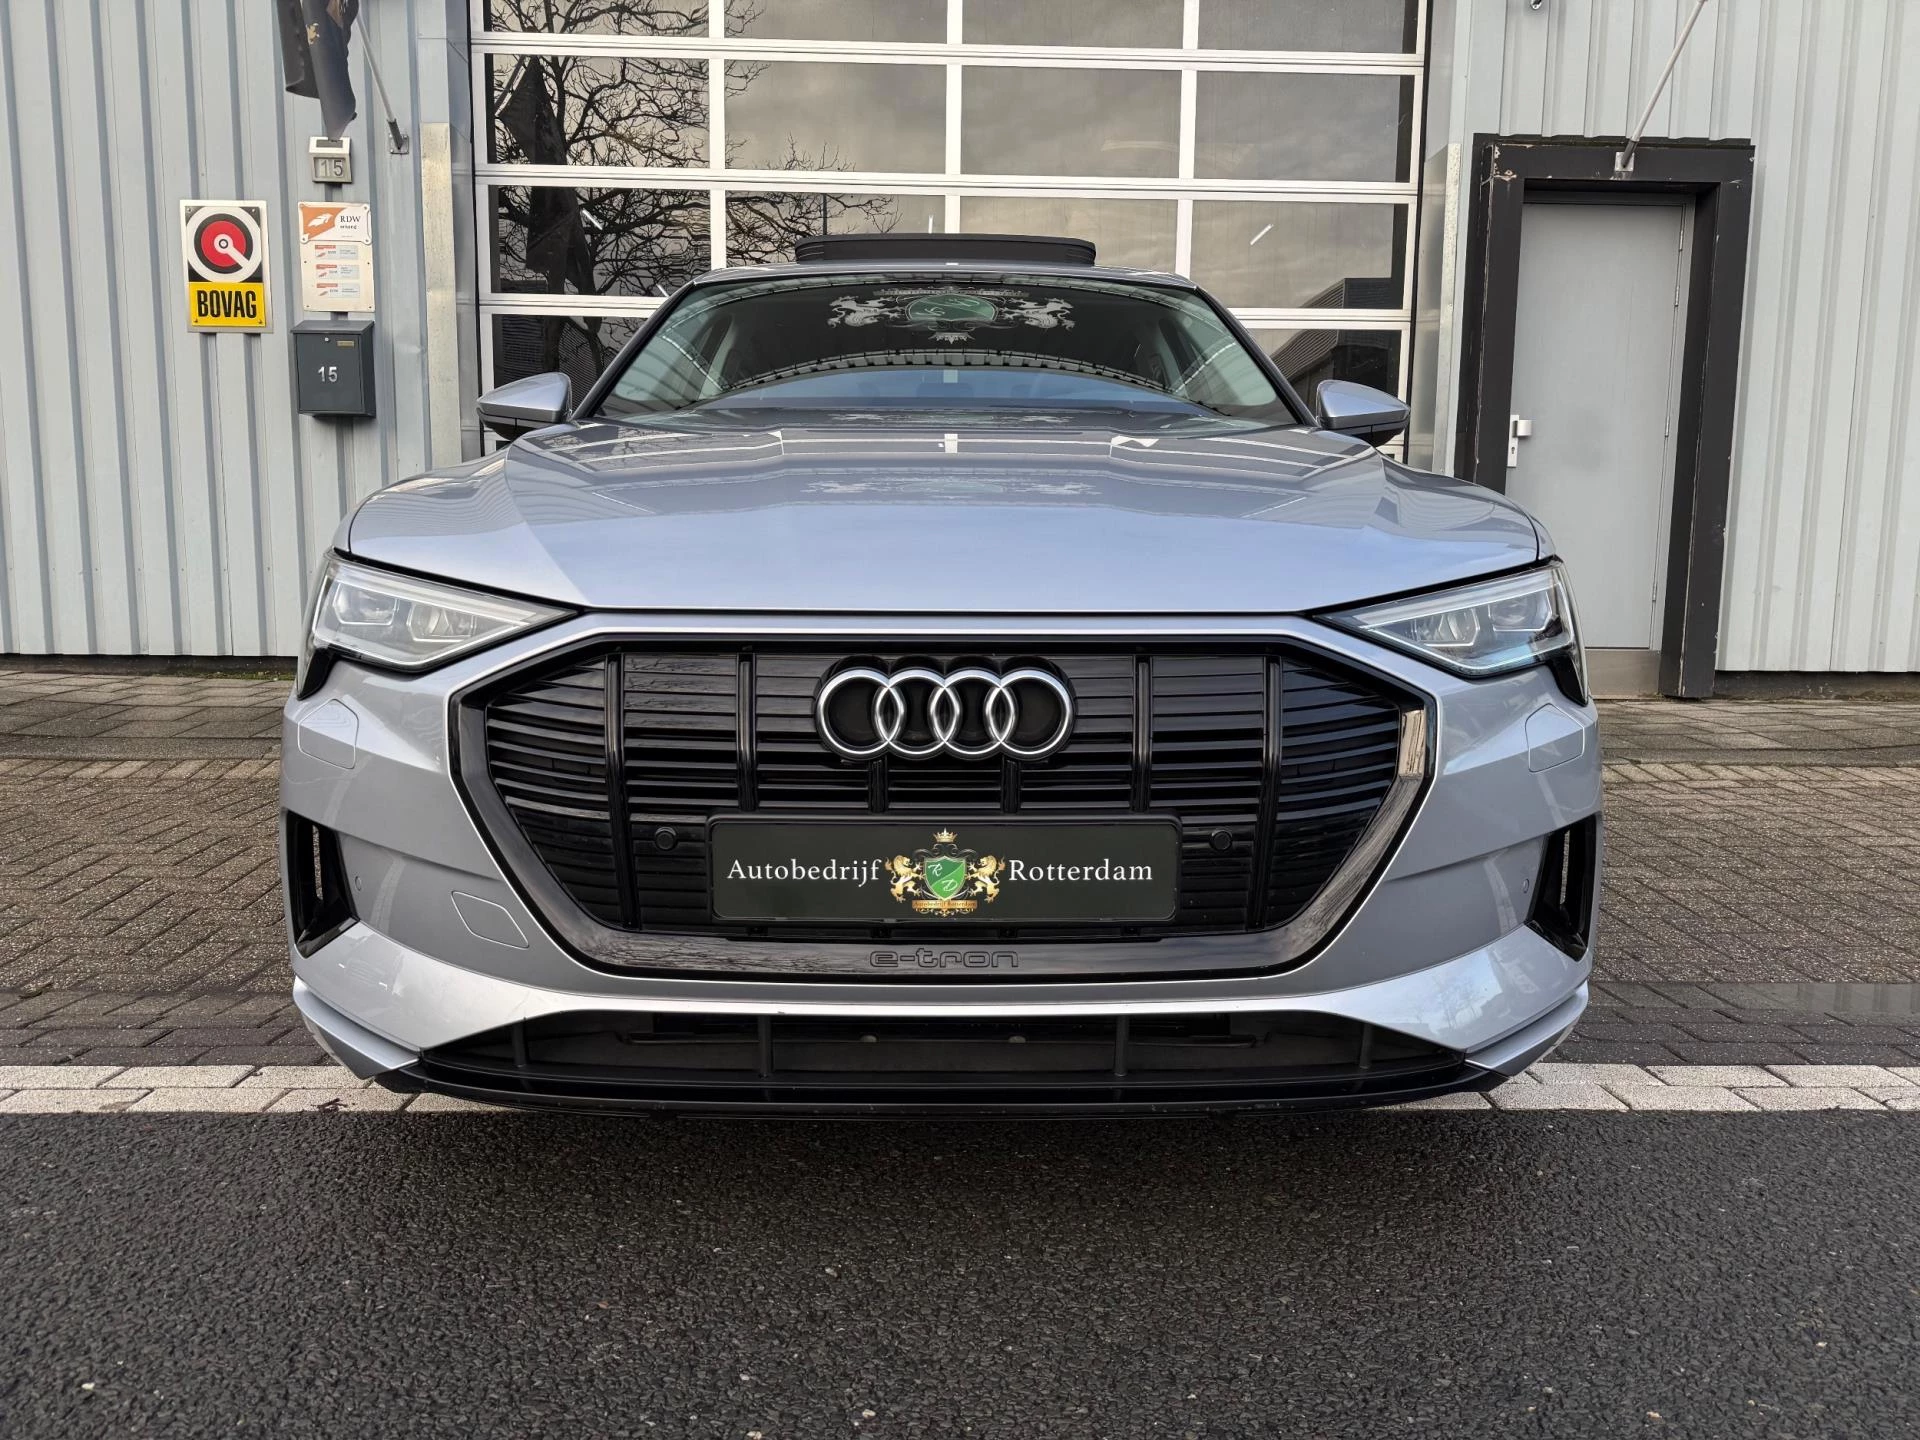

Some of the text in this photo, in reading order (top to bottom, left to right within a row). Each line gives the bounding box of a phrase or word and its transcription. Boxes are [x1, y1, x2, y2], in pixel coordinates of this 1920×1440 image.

[320, 159, 343, 177] 15
[340, 215, 361, 223] RDW
[197, 290, 257, 318] BOVAG
[317, 366, 338, 383] 15
[726, 858, 1154, 887] Autobedrijf Rotterdam
[927, 863, 943, 877] R
[869, 947, 1019, 969] e-tron
